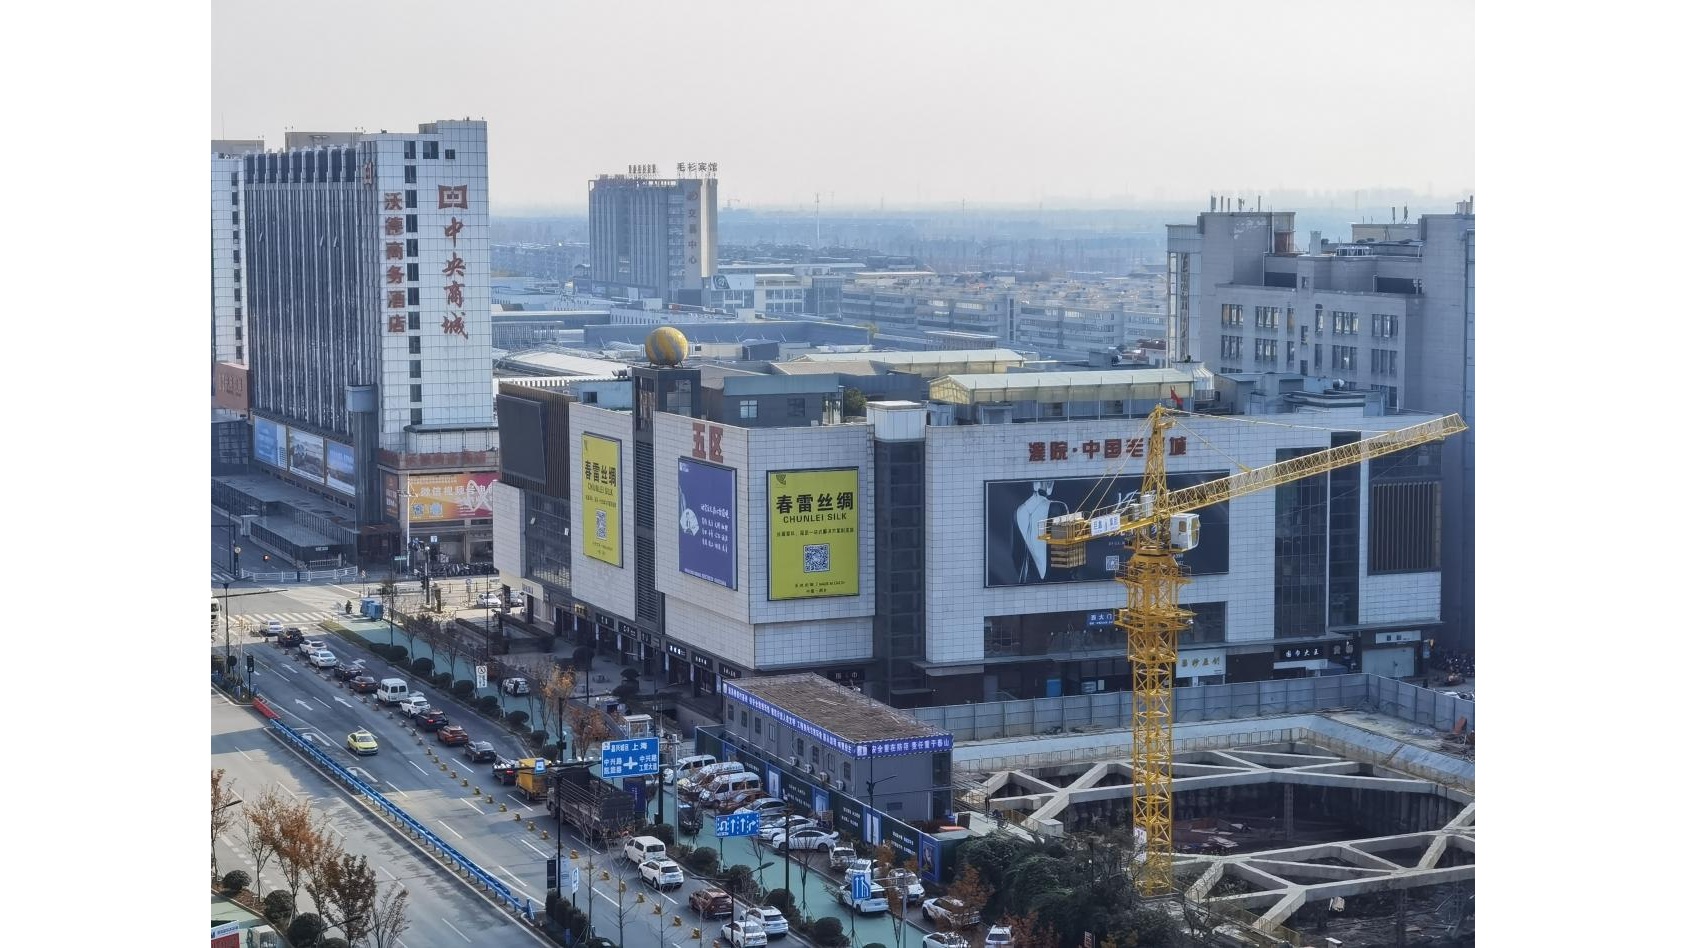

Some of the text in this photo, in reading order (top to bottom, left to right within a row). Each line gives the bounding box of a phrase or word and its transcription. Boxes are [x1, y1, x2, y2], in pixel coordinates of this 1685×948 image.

[384, 192, 407, 333] 沃德商务酒店
[441, 216, 469, 340] 中央商城
[692, 422, 724, 463] 五区
[1029, 436, 1187, 462] 濮院·中国毛城
[584, 459, 617, 488] 春雷丝绸
[775, 491, 854, 515] 春雷丝绸
[783, 512, 847, 524] CHUNLEI SILK
